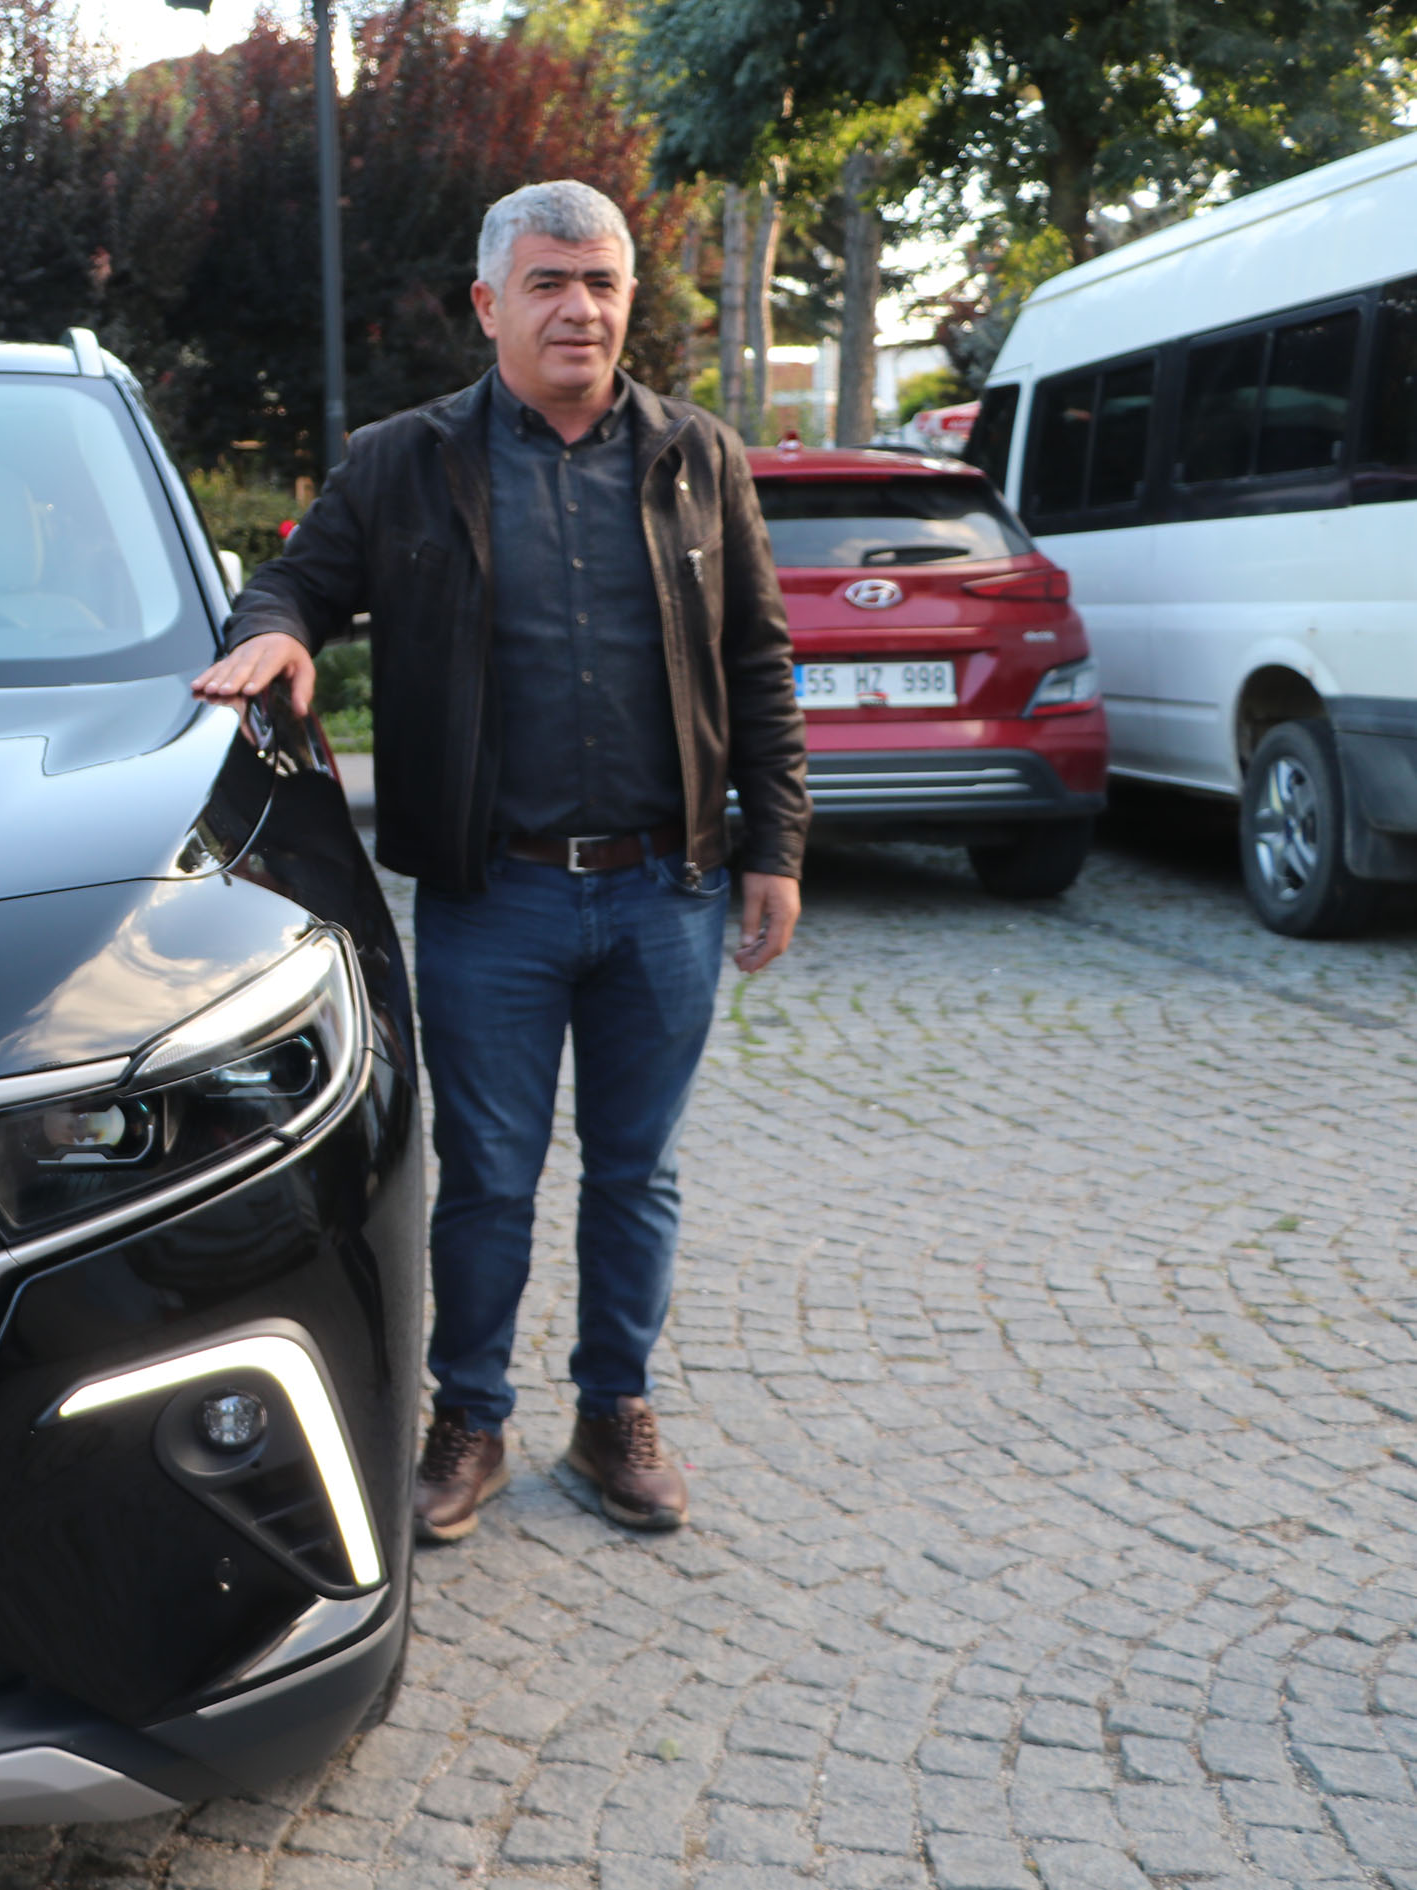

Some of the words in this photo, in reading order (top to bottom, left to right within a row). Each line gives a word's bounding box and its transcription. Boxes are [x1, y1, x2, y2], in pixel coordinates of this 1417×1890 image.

[807, 666, 836, 694] 55
[853, 665, 883, 693] HZ
[902, 665, 946, 693] 998
